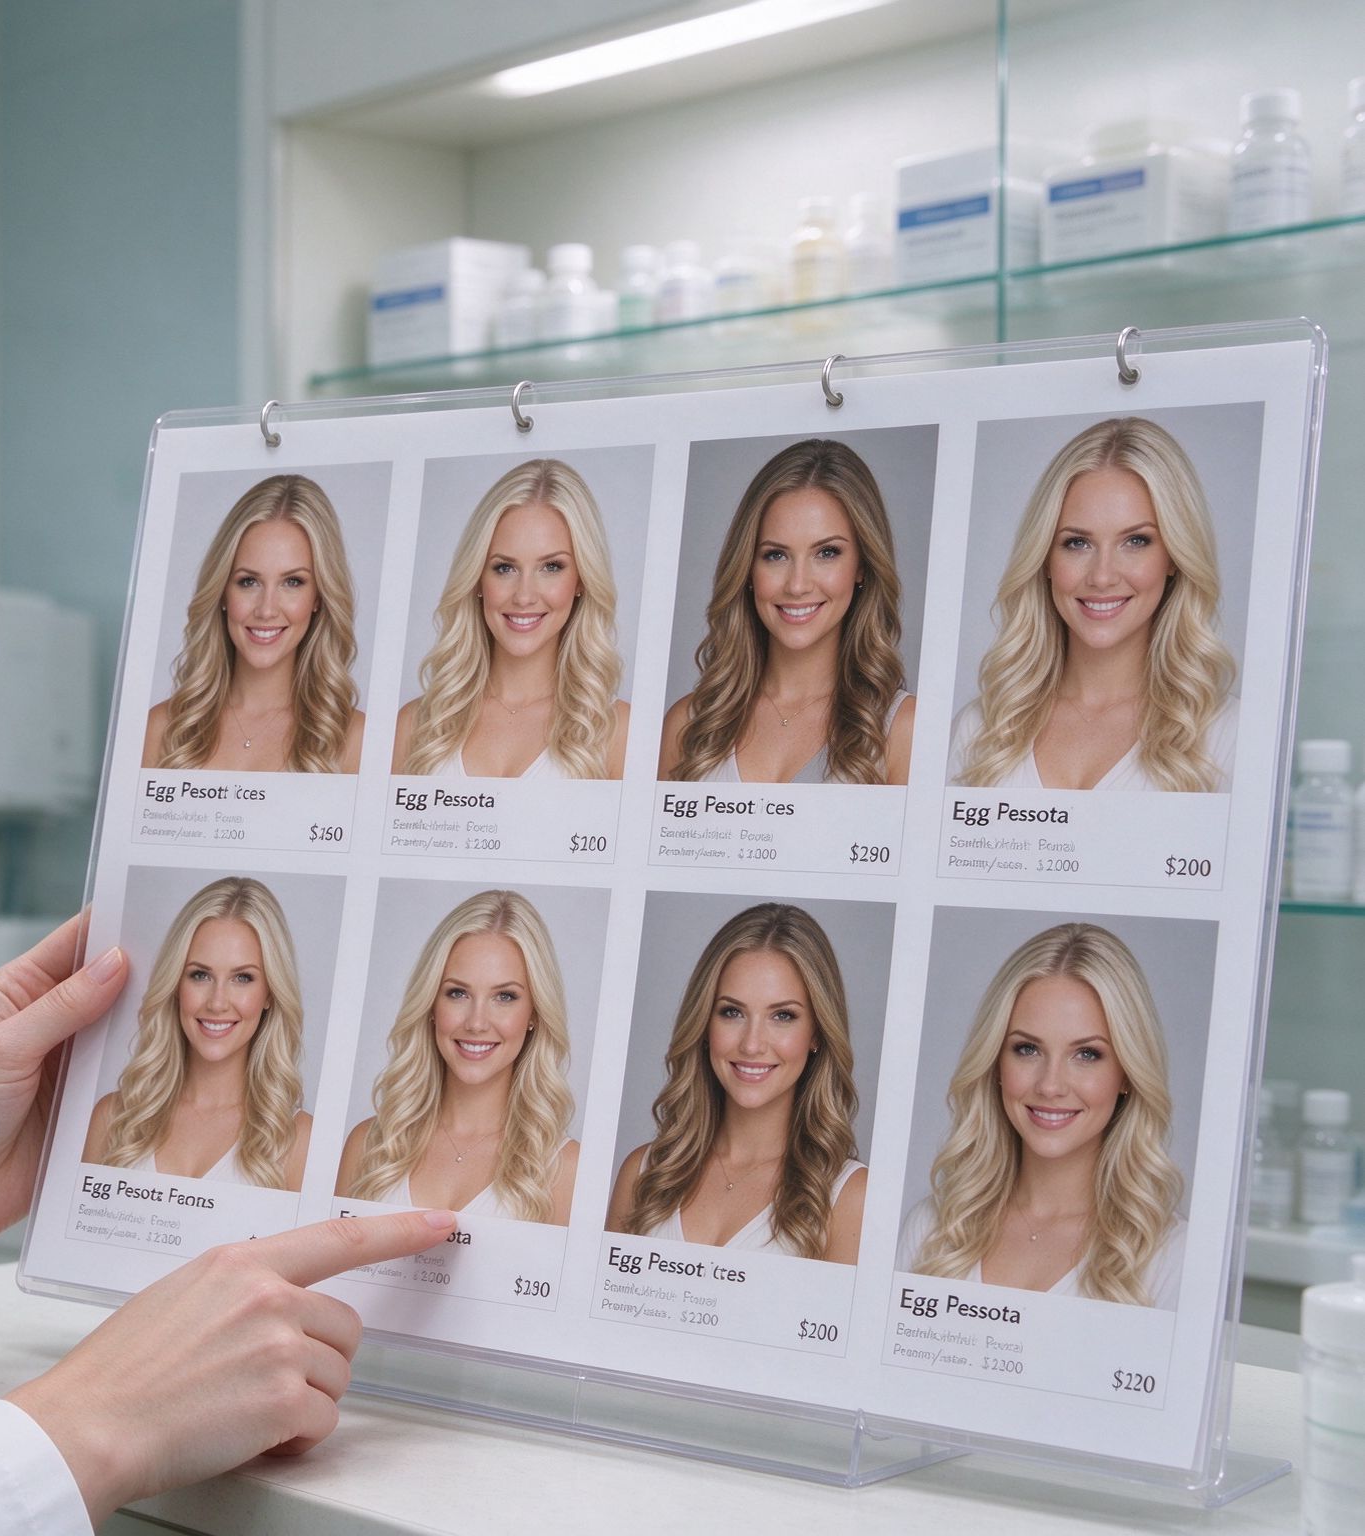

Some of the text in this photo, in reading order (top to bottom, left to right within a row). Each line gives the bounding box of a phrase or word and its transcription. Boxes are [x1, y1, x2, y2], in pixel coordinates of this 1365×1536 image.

[145, 780, 176, 803] Egg
[395, 788, 495, 811] Egg Pessota
[663, 794, 698, 818] Egg
[952, 801, 1069, 827] Egg Pessota
[1165, 854, 1212, 877] $200
[82, 1176, 112, 1200] Egg
[608, 1246, 643, 1275] Egg
[900, 1288, 1021, 1324] Egg Pessota
[797, 1318, 839, 1342] $200
[1112, 1367, 1156, 1393] $220
